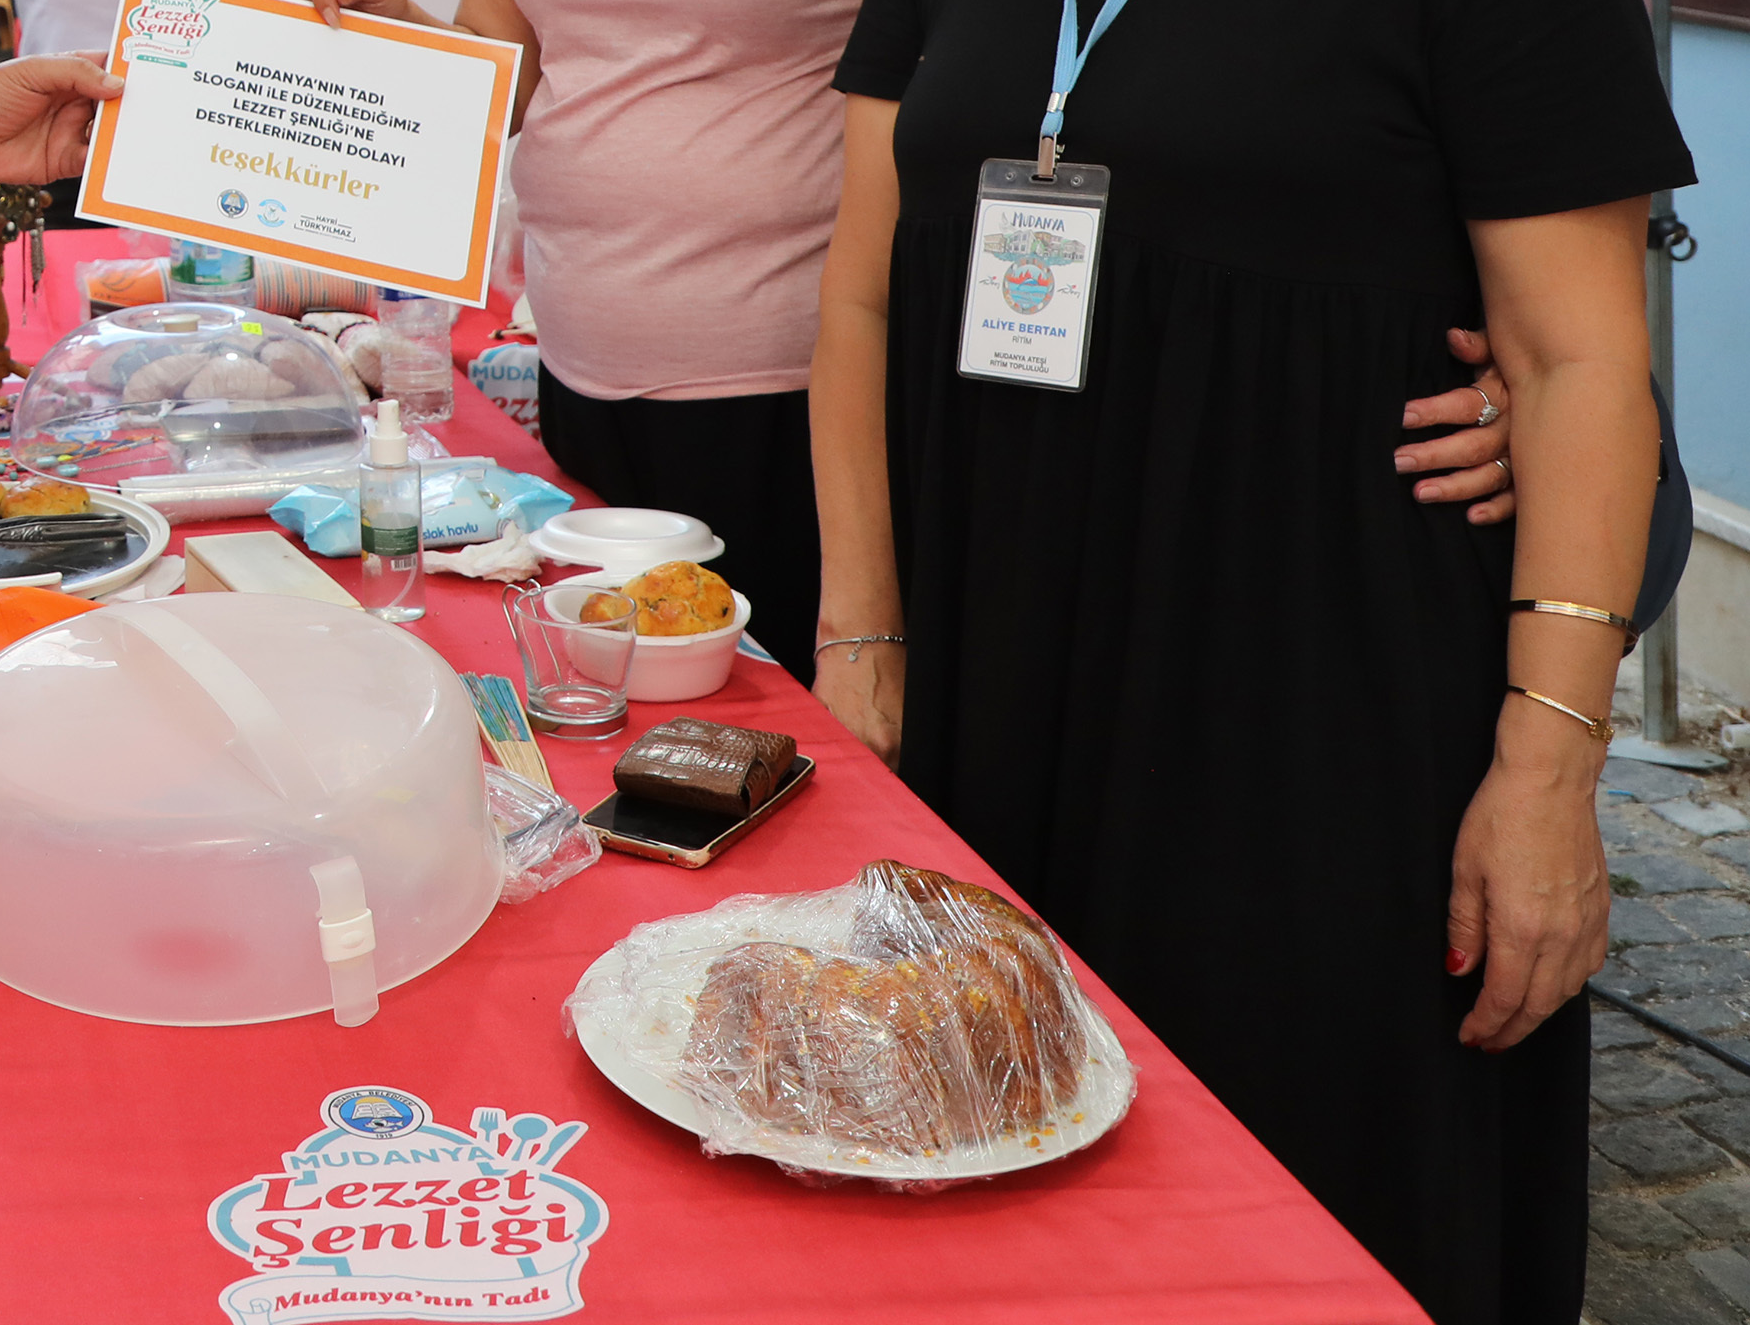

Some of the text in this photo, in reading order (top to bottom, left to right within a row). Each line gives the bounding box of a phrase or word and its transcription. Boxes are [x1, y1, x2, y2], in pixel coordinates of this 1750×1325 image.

[141, 6, 201, 23] Lezzet
[134, 18, 204, 39] Şenliği
[235, 60, 384, 106] MUDANYA'NIN TADI
[193, 70, 263, 96] SLOGANI
[292, 93, 421, 134] DÜZENLEDİĞİMİZ
[233, 98, 375, 141] LEZZET ŞENLİĞİ'NE
[195, 108, 406, 168] DESTEKLERİNİZDEN DOLAYI
[209, 142, 380, 200] teşekkürler
[300, 219, 351, 237] TÜRKYILMAZ
[316, 215, 338, 225] HAYRİ
[1012, 211, 1065, 232] MUDANYA
[981, 318, 1067, 337] ALİYE BERTAN
[1012, 335, 1032, 345] RİTİM
[994, 351, 1026, 362] MUDANYA
[472, 365, 537, 381] MUDA
[423, 527, 445, 540] slak
[447, 522, 479, 537] havlu
[290, 1145, 496, 1170] MUDANYA
[255, 1170, 535, 1212] Lezzet
[253, 1203, 574, 1268] Şenliği
[483, 1286, 551, 1307] Tadı
